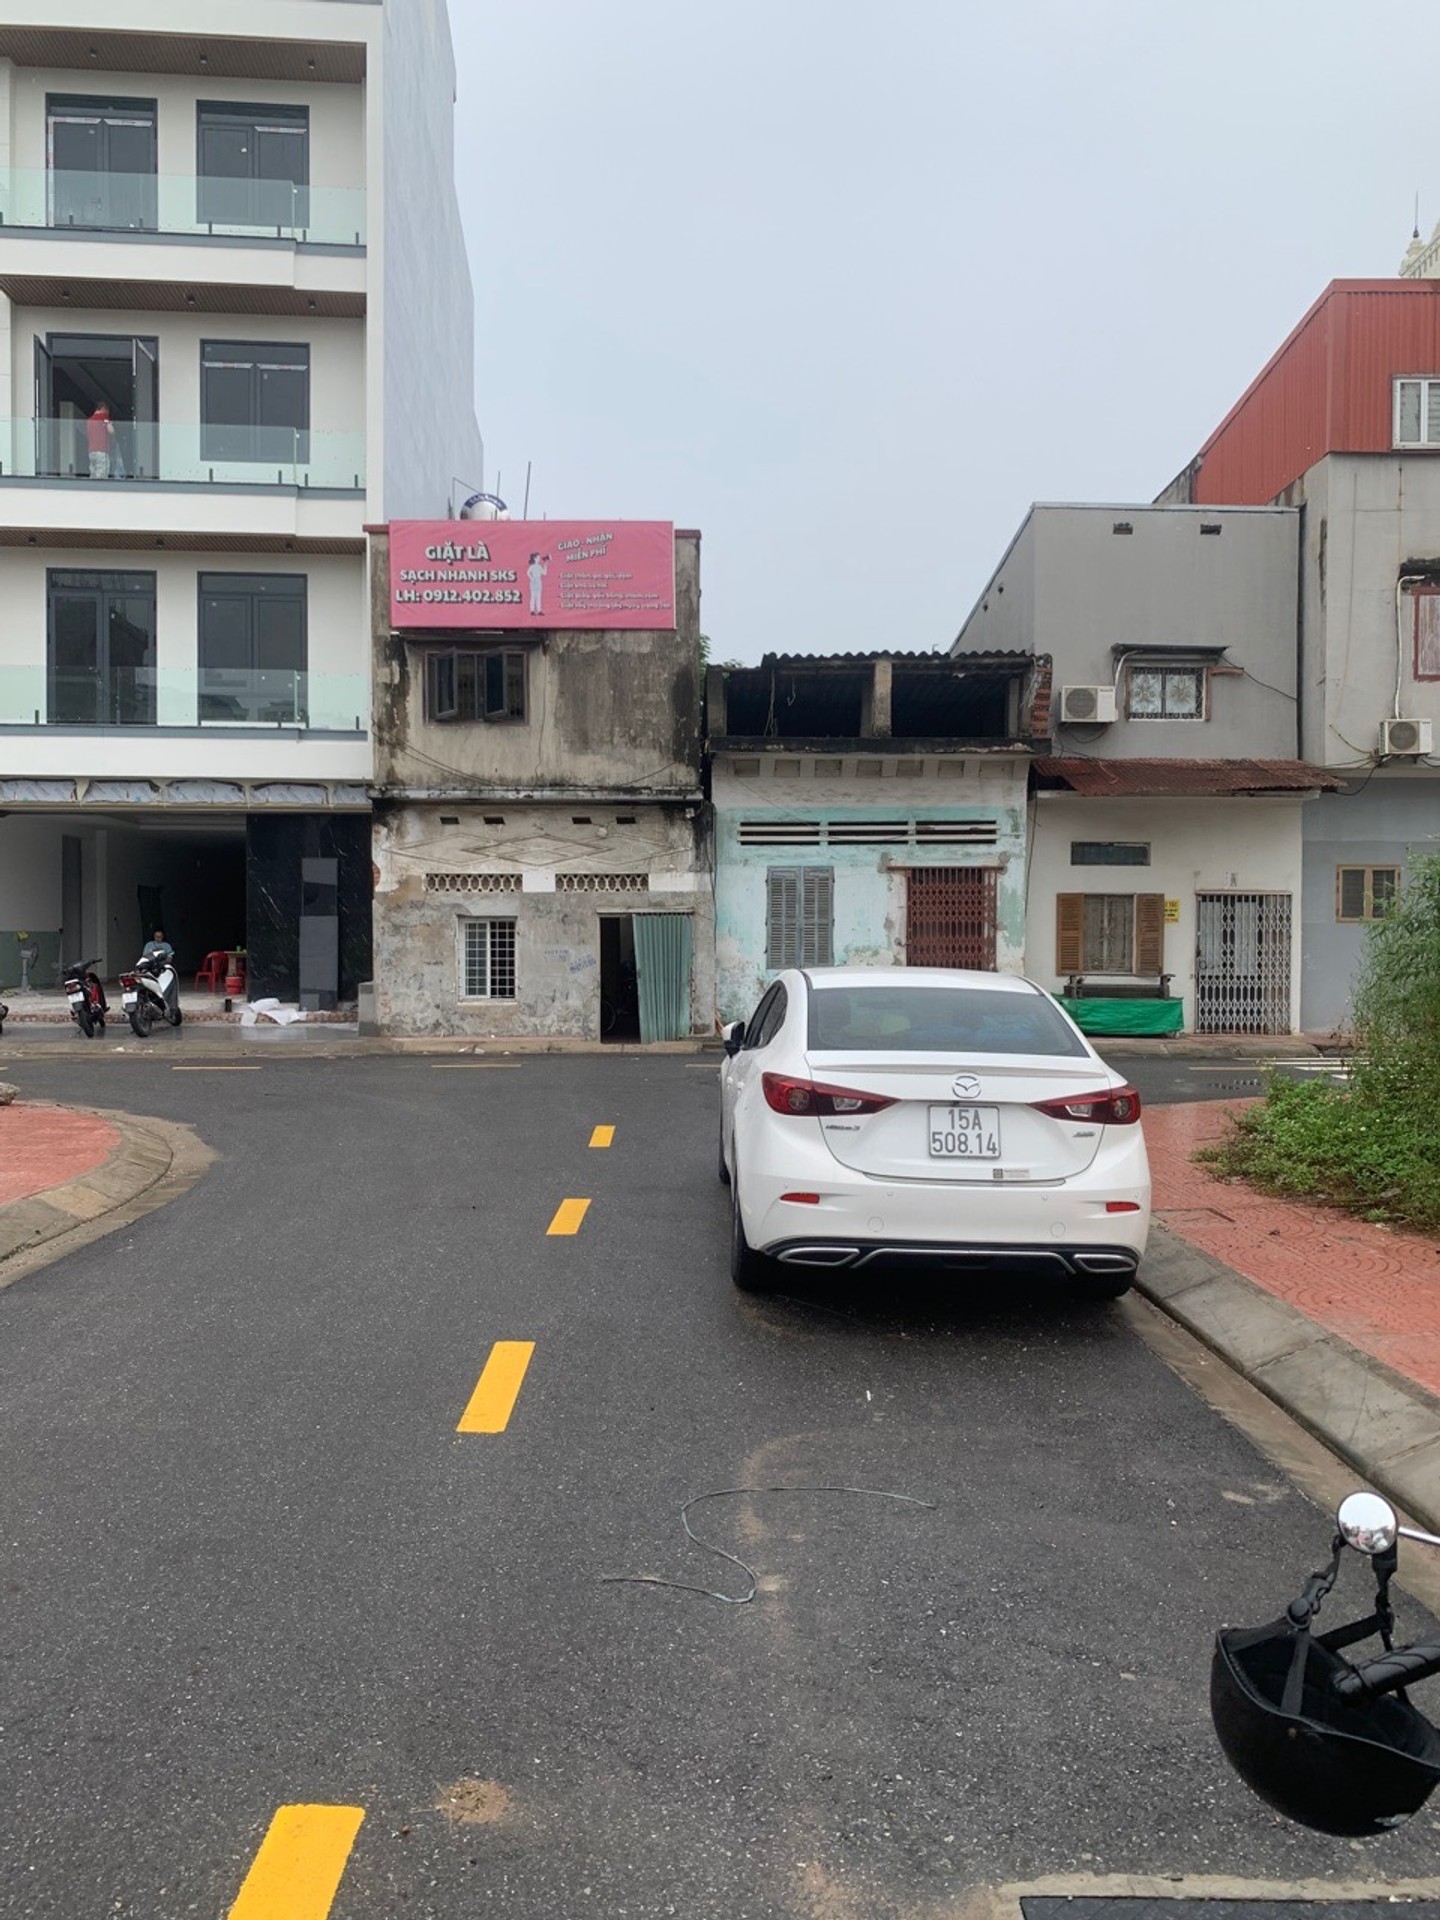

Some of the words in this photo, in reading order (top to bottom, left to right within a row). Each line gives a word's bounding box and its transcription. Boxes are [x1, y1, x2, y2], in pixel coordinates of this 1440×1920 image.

[424, 540, 466, 565] GIẶT
[467, 540, 490, 561] LÀ
[558, 539, 581, 551] GIAO
[400, 569, 436, 584] SẠCH
[437, 569, 488, 582] NHANH
[489, 569, 517, 582] SKS
[395, 589, 420, 603] LH:
[422, 589, 522, 603] 0912.402.852
[948, 1108, 983, 1131] 15A
[931, 1131, 998, 1155] 508.14
